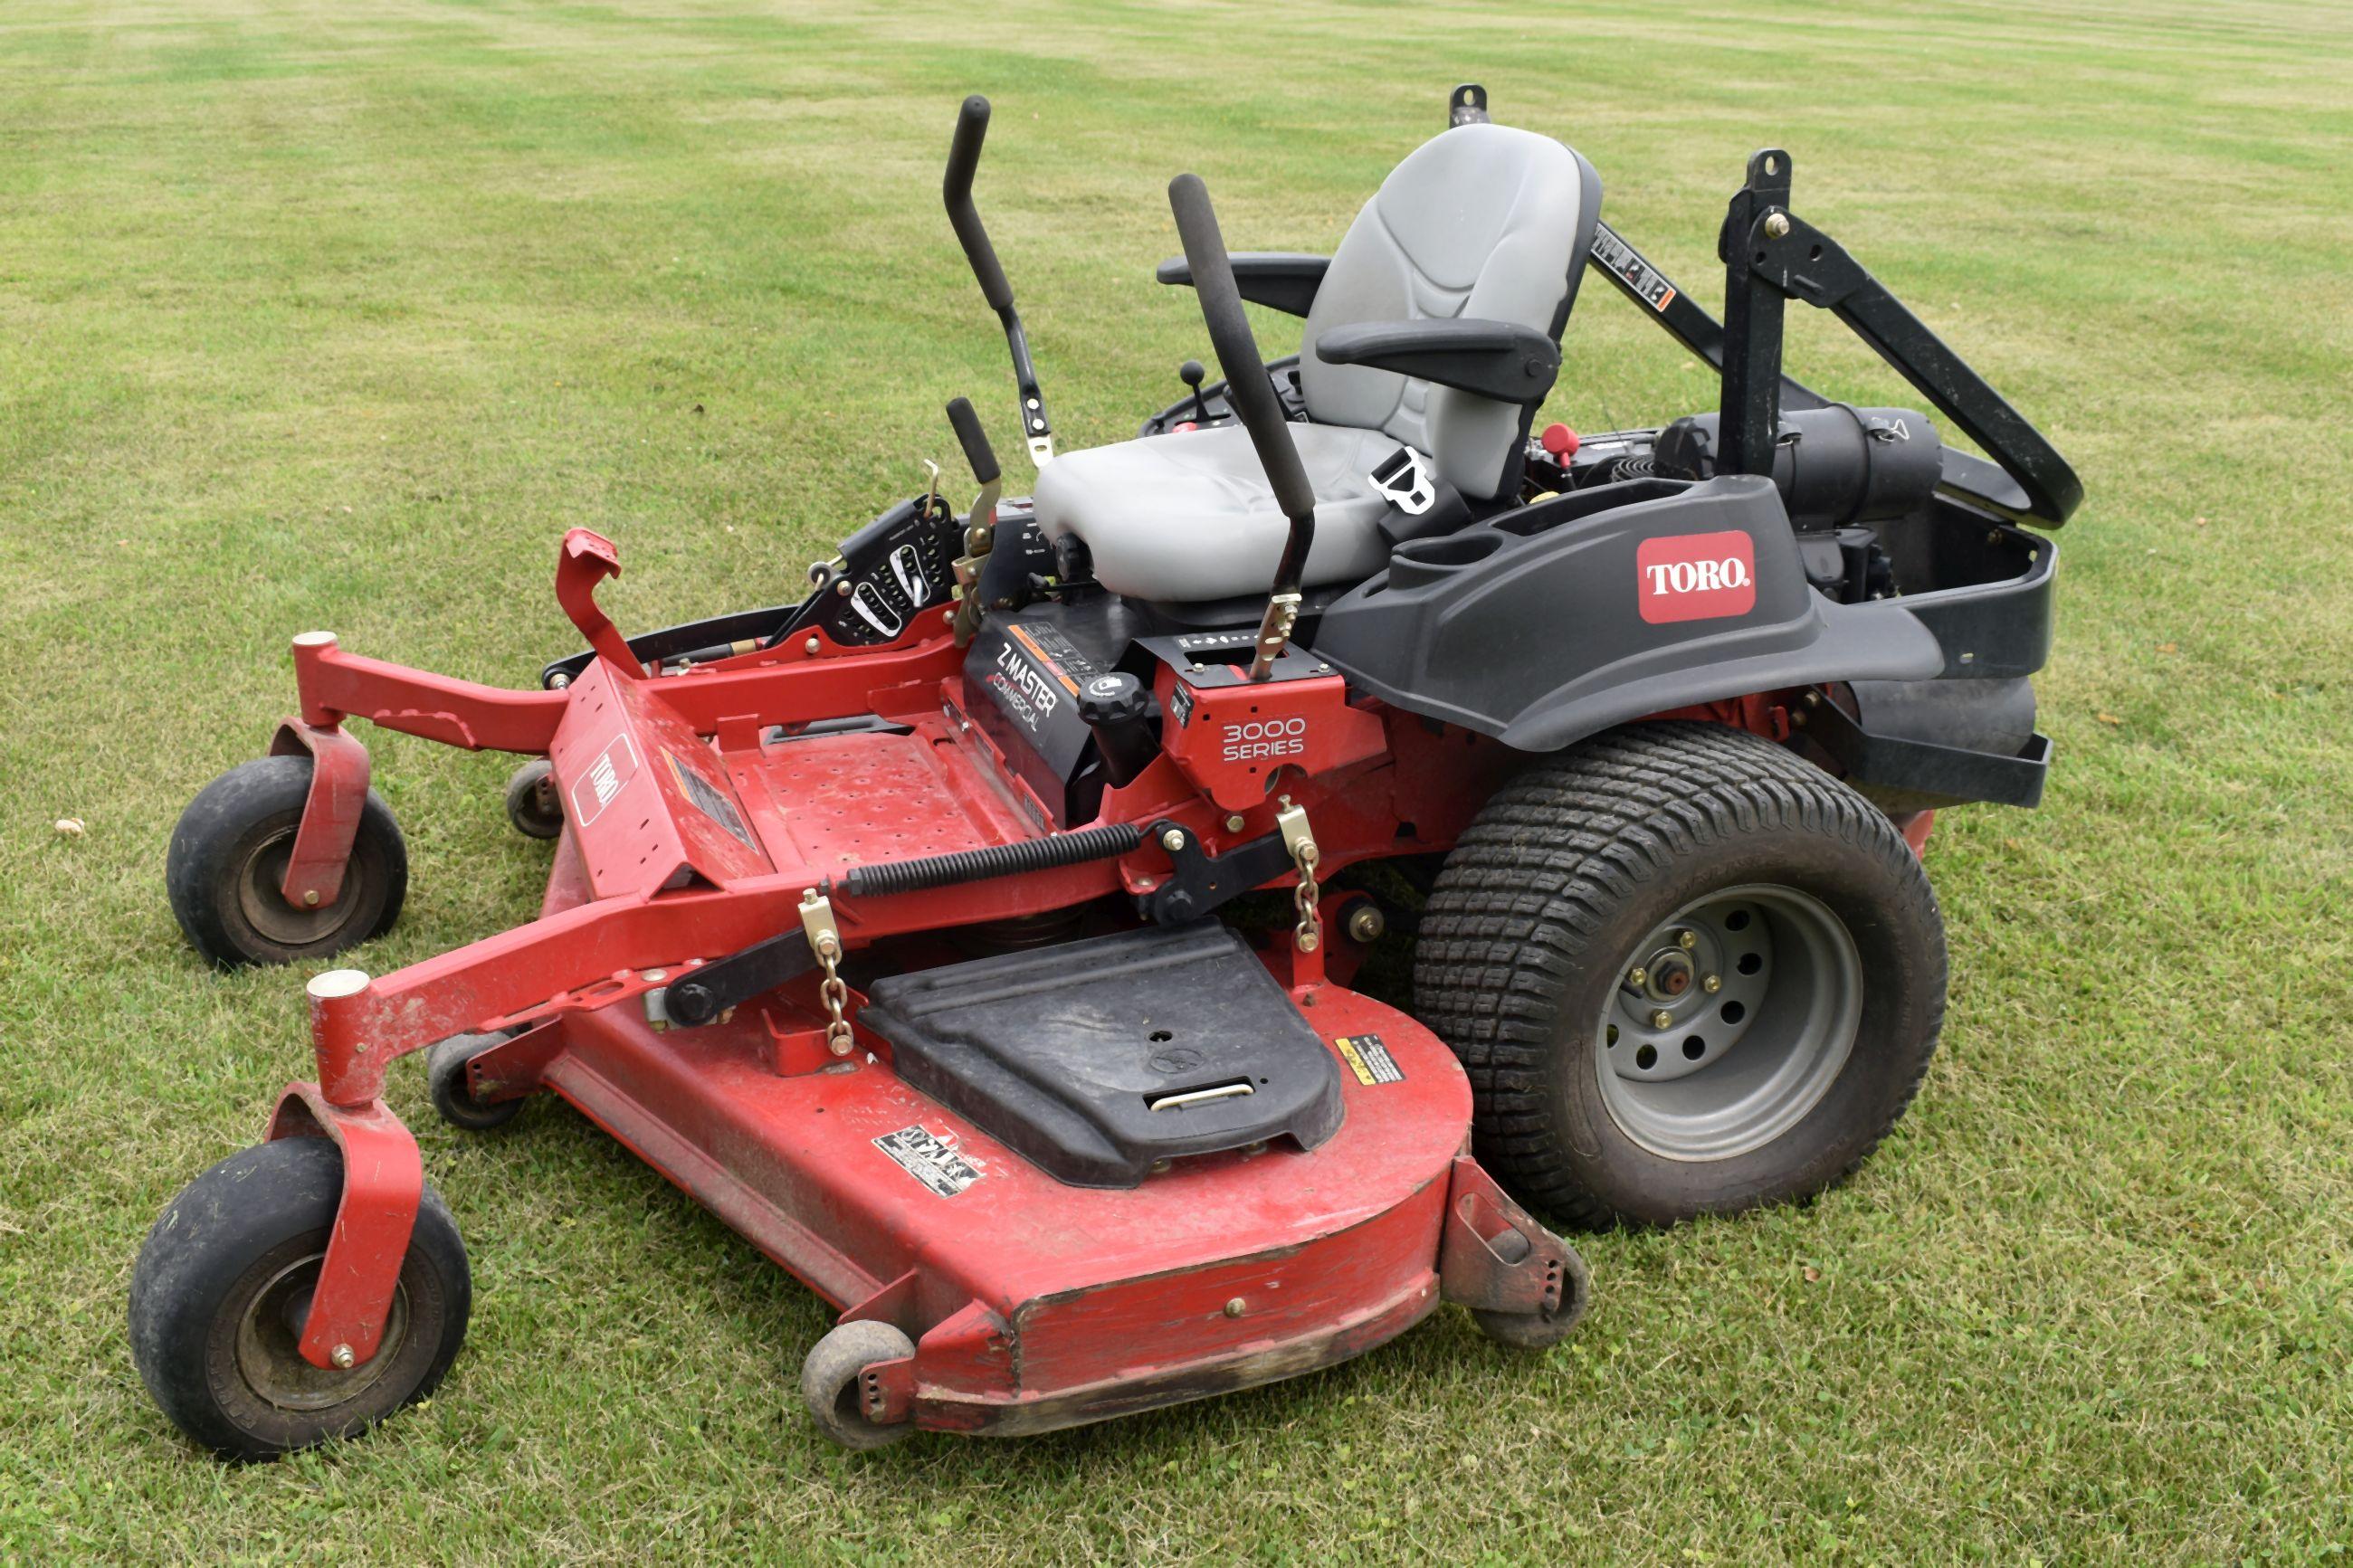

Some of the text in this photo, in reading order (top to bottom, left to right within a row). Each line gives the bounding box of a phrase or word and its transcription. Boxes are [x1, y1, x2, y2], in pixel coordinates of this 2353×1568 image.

[1646, 557, 1747, 594] TORO
[997, 642, 1057, 717] Z MASTER
[994, 672, 1039, 731] COMMERCIAL
[1224, 717, 1306, 743] 3000
[1224, 738, 1304, 761] SERIES
